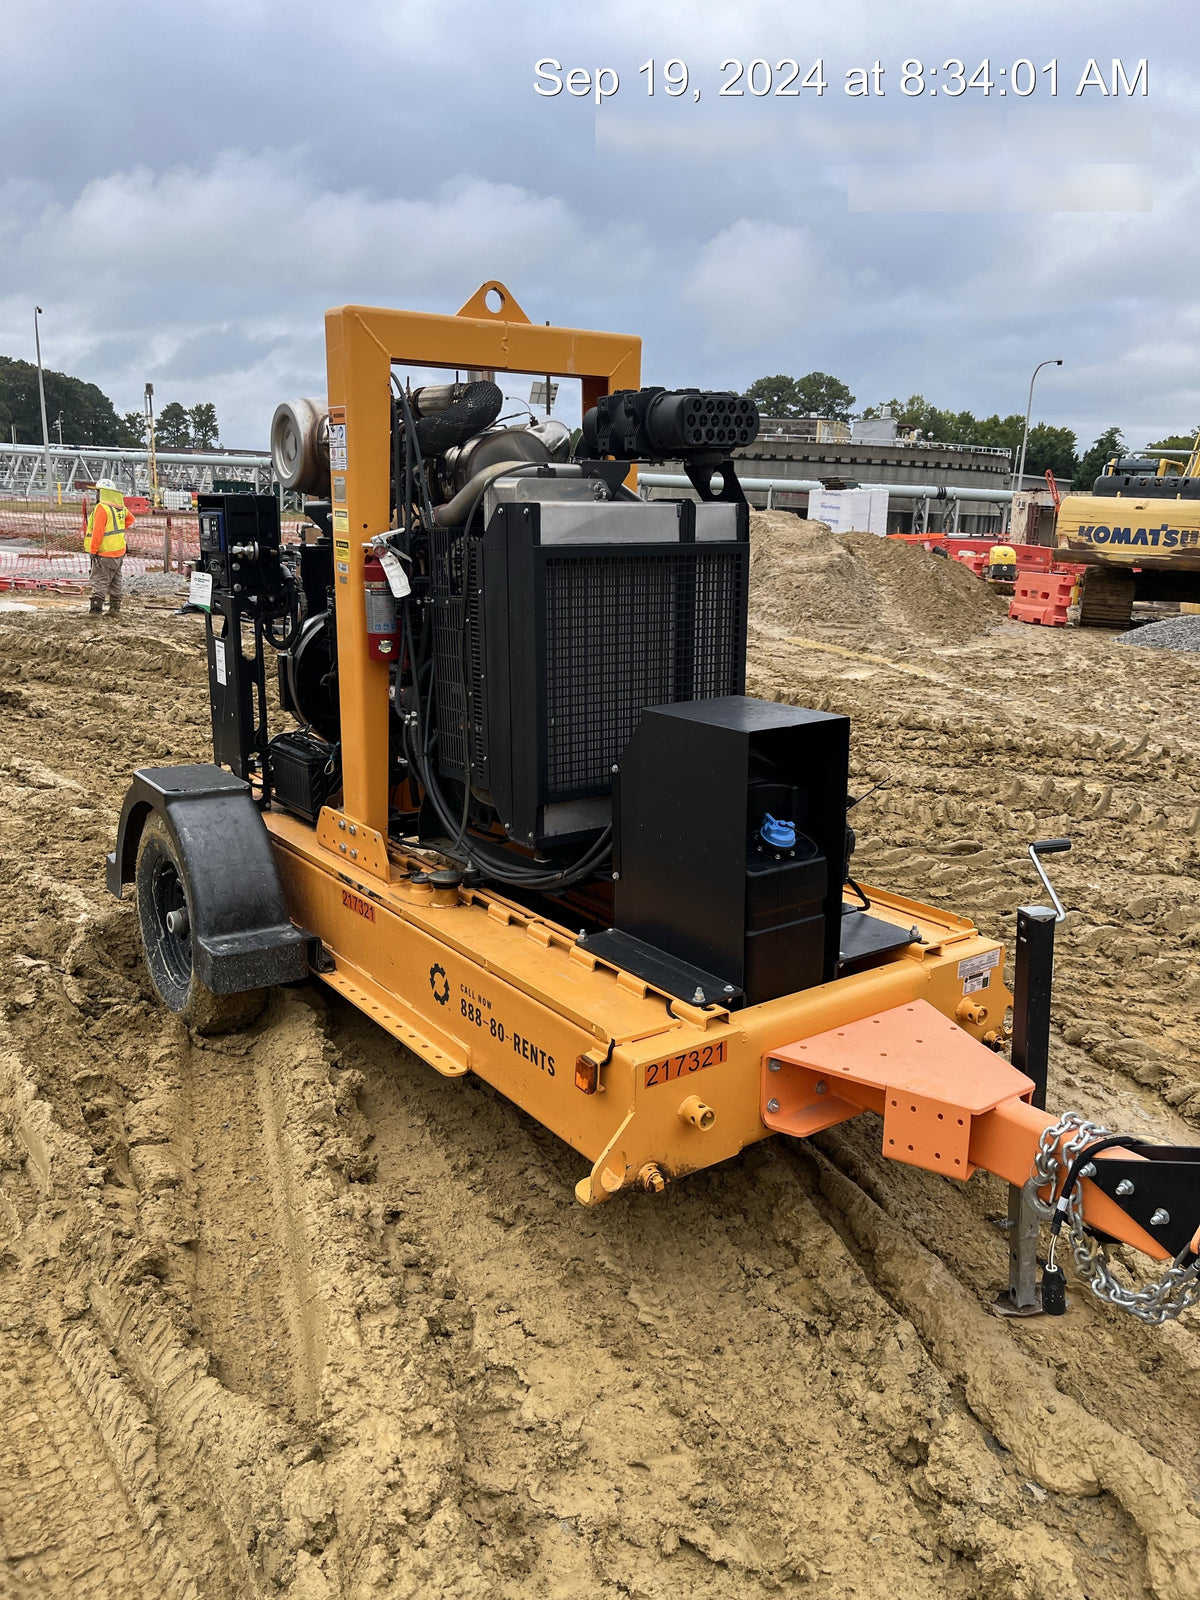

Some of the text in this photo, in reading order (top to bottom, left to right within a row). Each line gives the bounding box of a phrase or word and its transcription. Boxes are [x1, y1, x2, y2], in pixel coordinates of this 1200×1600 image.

[1077, 523, 1200, 548] KOMATSU
[342, 889, 375, 923] 217321
[460, 983, 492, 1010] CALL NOW
[646, 1041, 724, 1088] 217321
